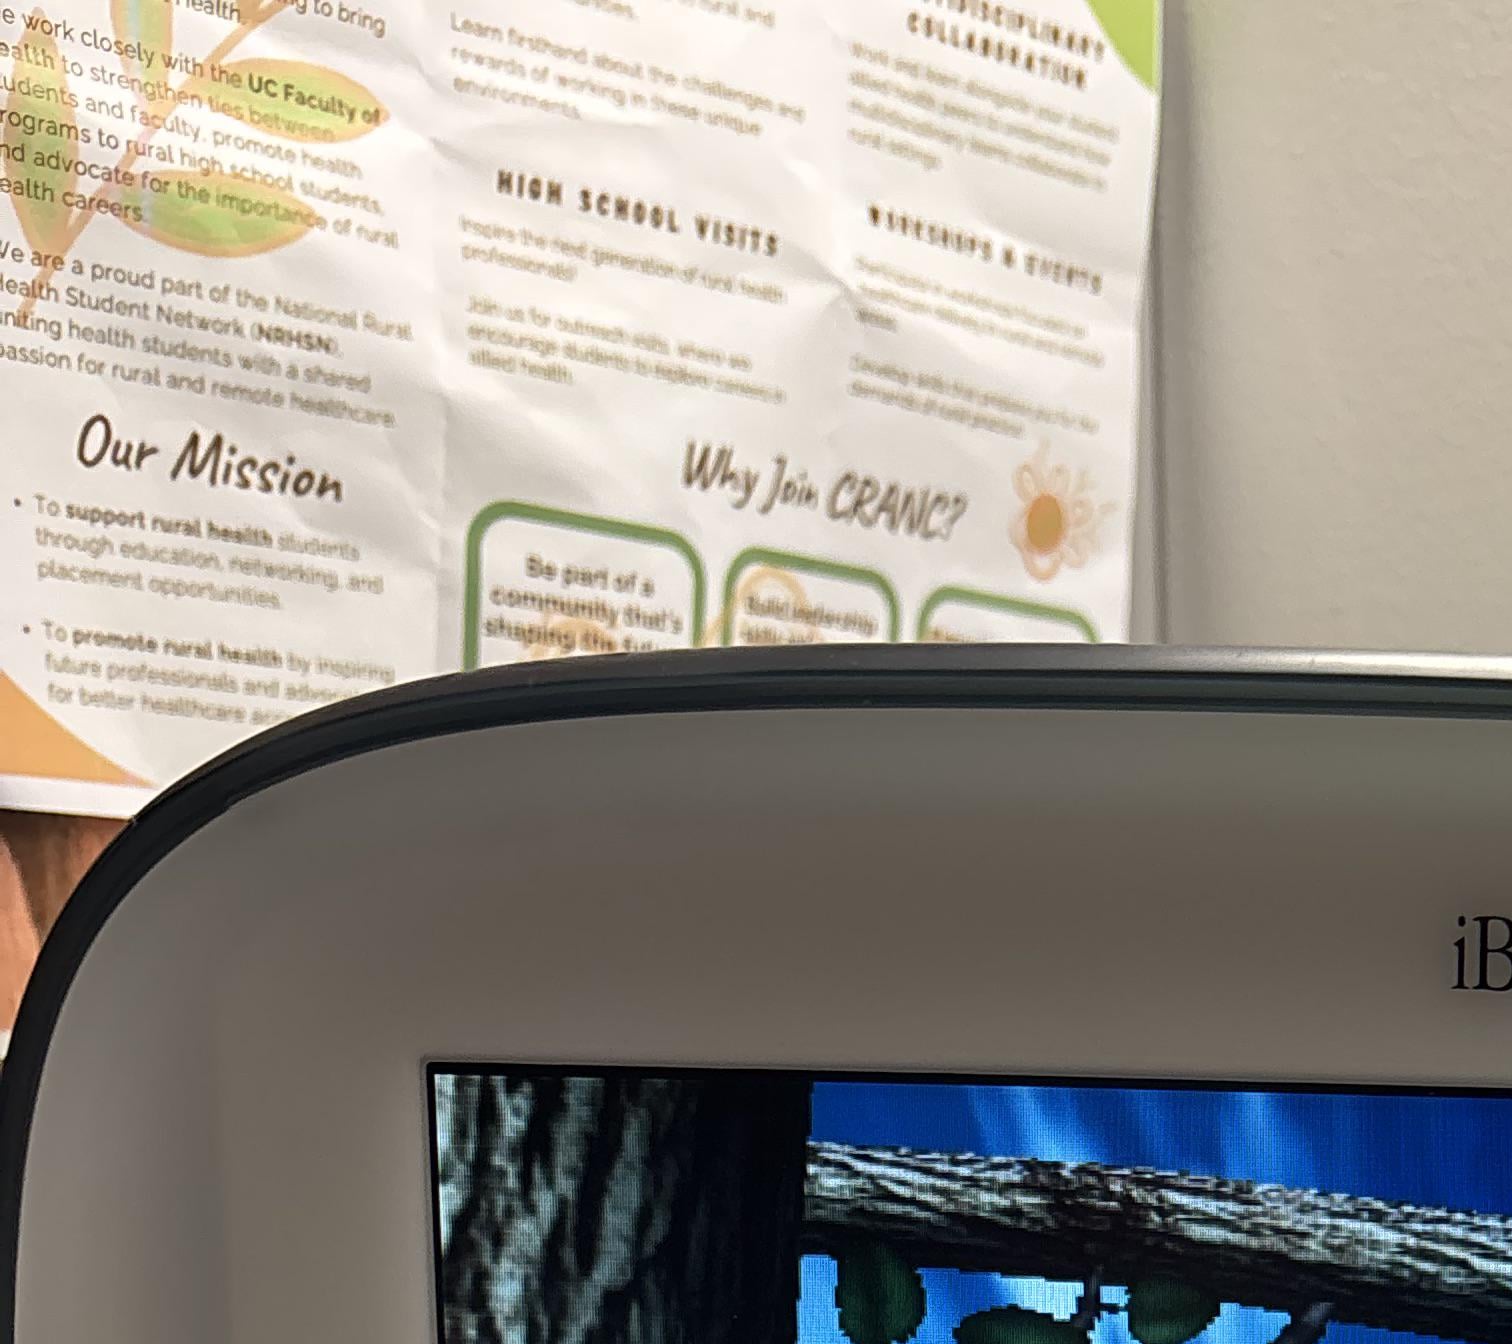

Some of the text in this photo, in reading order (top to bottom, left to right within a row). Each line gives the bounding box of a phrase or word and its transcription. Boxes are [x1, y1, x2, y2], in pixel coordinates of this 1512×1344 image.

[337, 7, 385, 38] bring
[907, 12, 1087, 91] COLLABORATION
[0, 43, 336, 141] ealth to strengthen ties between
[22, 12, 380, 126] work closely with the UC Faculty of
[0, 76, 363, 180] udents and promote health
[0, 110, 294, 192] rograms to rural high school
[0, 178, 54, 203] ealth
[0, 143, 399, 249] nd advocate for the importance of rural
[496, 168, 563, 206] HIGH
[578, 186, 681, 235] SCHOOL
[692, 213, 780, 259] VISITS
[31, 250, 64, 271] are
[71, 259, 83, 275] a
[91, 263, 155, 290] proud
[161, 276, 203, 300] part
[209, 284, 231, 304] of
[236, 288, 268, 313] the
[65, 285, 245, 340] Student Network
[68, 317, 135, 351] health
[142, 336, 233, 369] students
[77, 352, 106, 378] for
[111, 362, 161, 388] rural
[165, 372, 206, 396] and
[77, 413, 344, 504] Our Mission
[34, 492, 61, 517] To
[65, 502, 146, 532] support
[151, 513, 202, 540] rural
[206, 519, 273, 550] health
[682, 440, 969, 542] Why Join CRANC?
[35, 526, 115, 561] through
[525, 552, 557, 582] Be
[562, 563, 609, 591] part
[41, 618, 68, 643] To
[72, 627, 159, 657] promote
[488, 585, 619, 630] community
